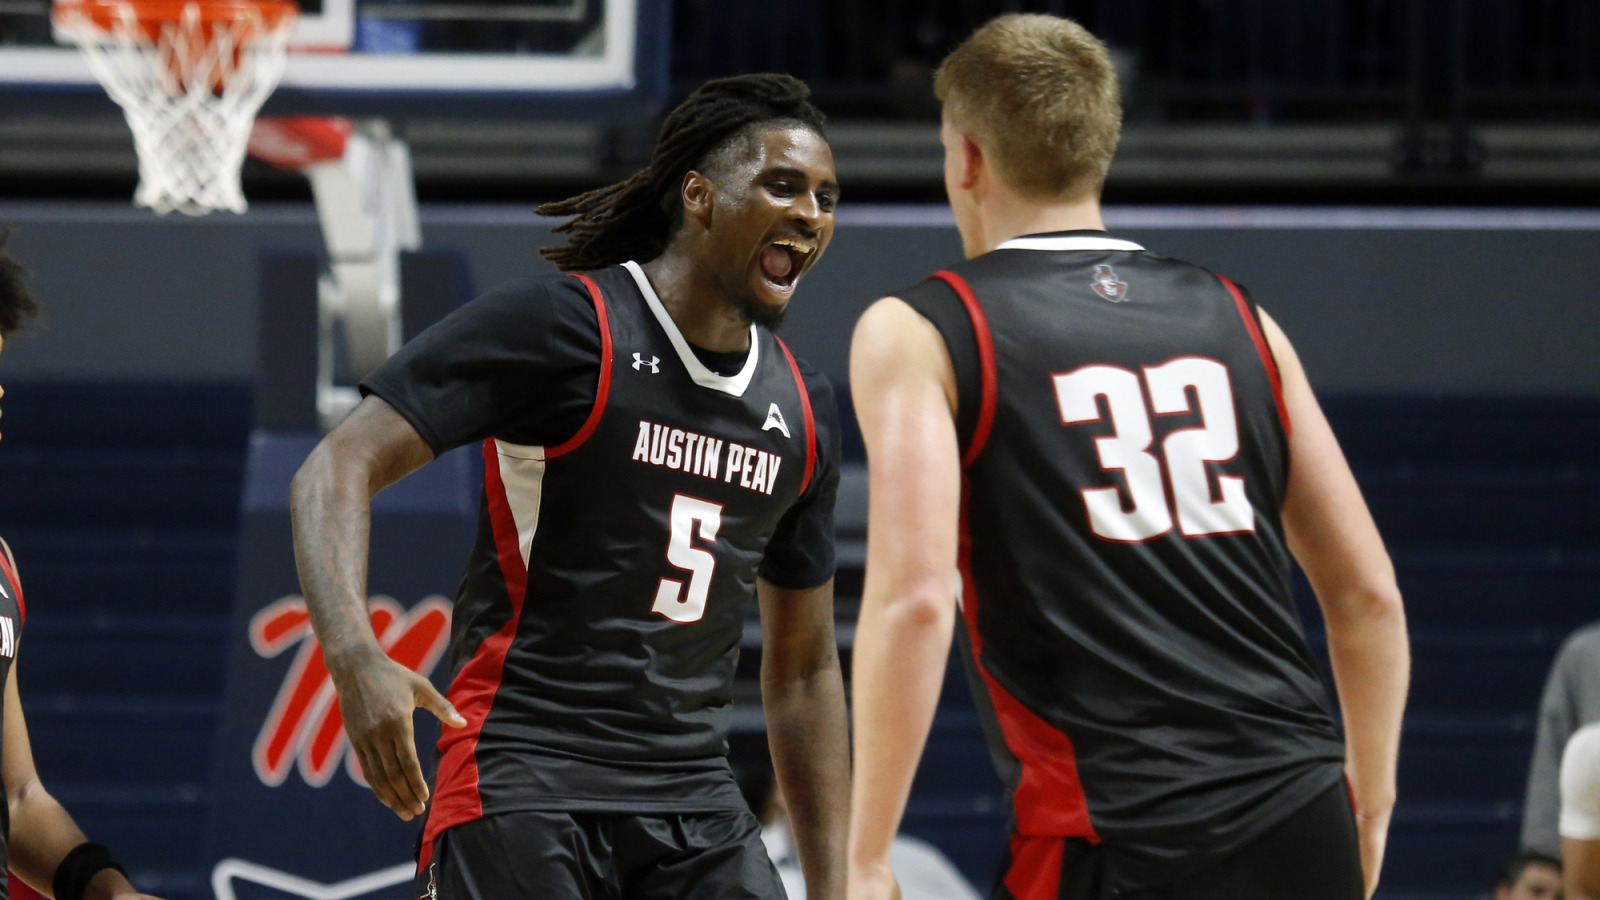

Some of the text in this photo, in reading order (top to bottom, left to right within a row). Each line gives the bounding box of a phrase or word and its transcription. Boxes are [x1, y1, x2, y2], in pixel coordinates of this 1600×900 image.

[632, 420, 782, 495] AUSTIN PEAY
[1051, 355, 1256, 542] 32
[651, 492, 724, 623] 5
